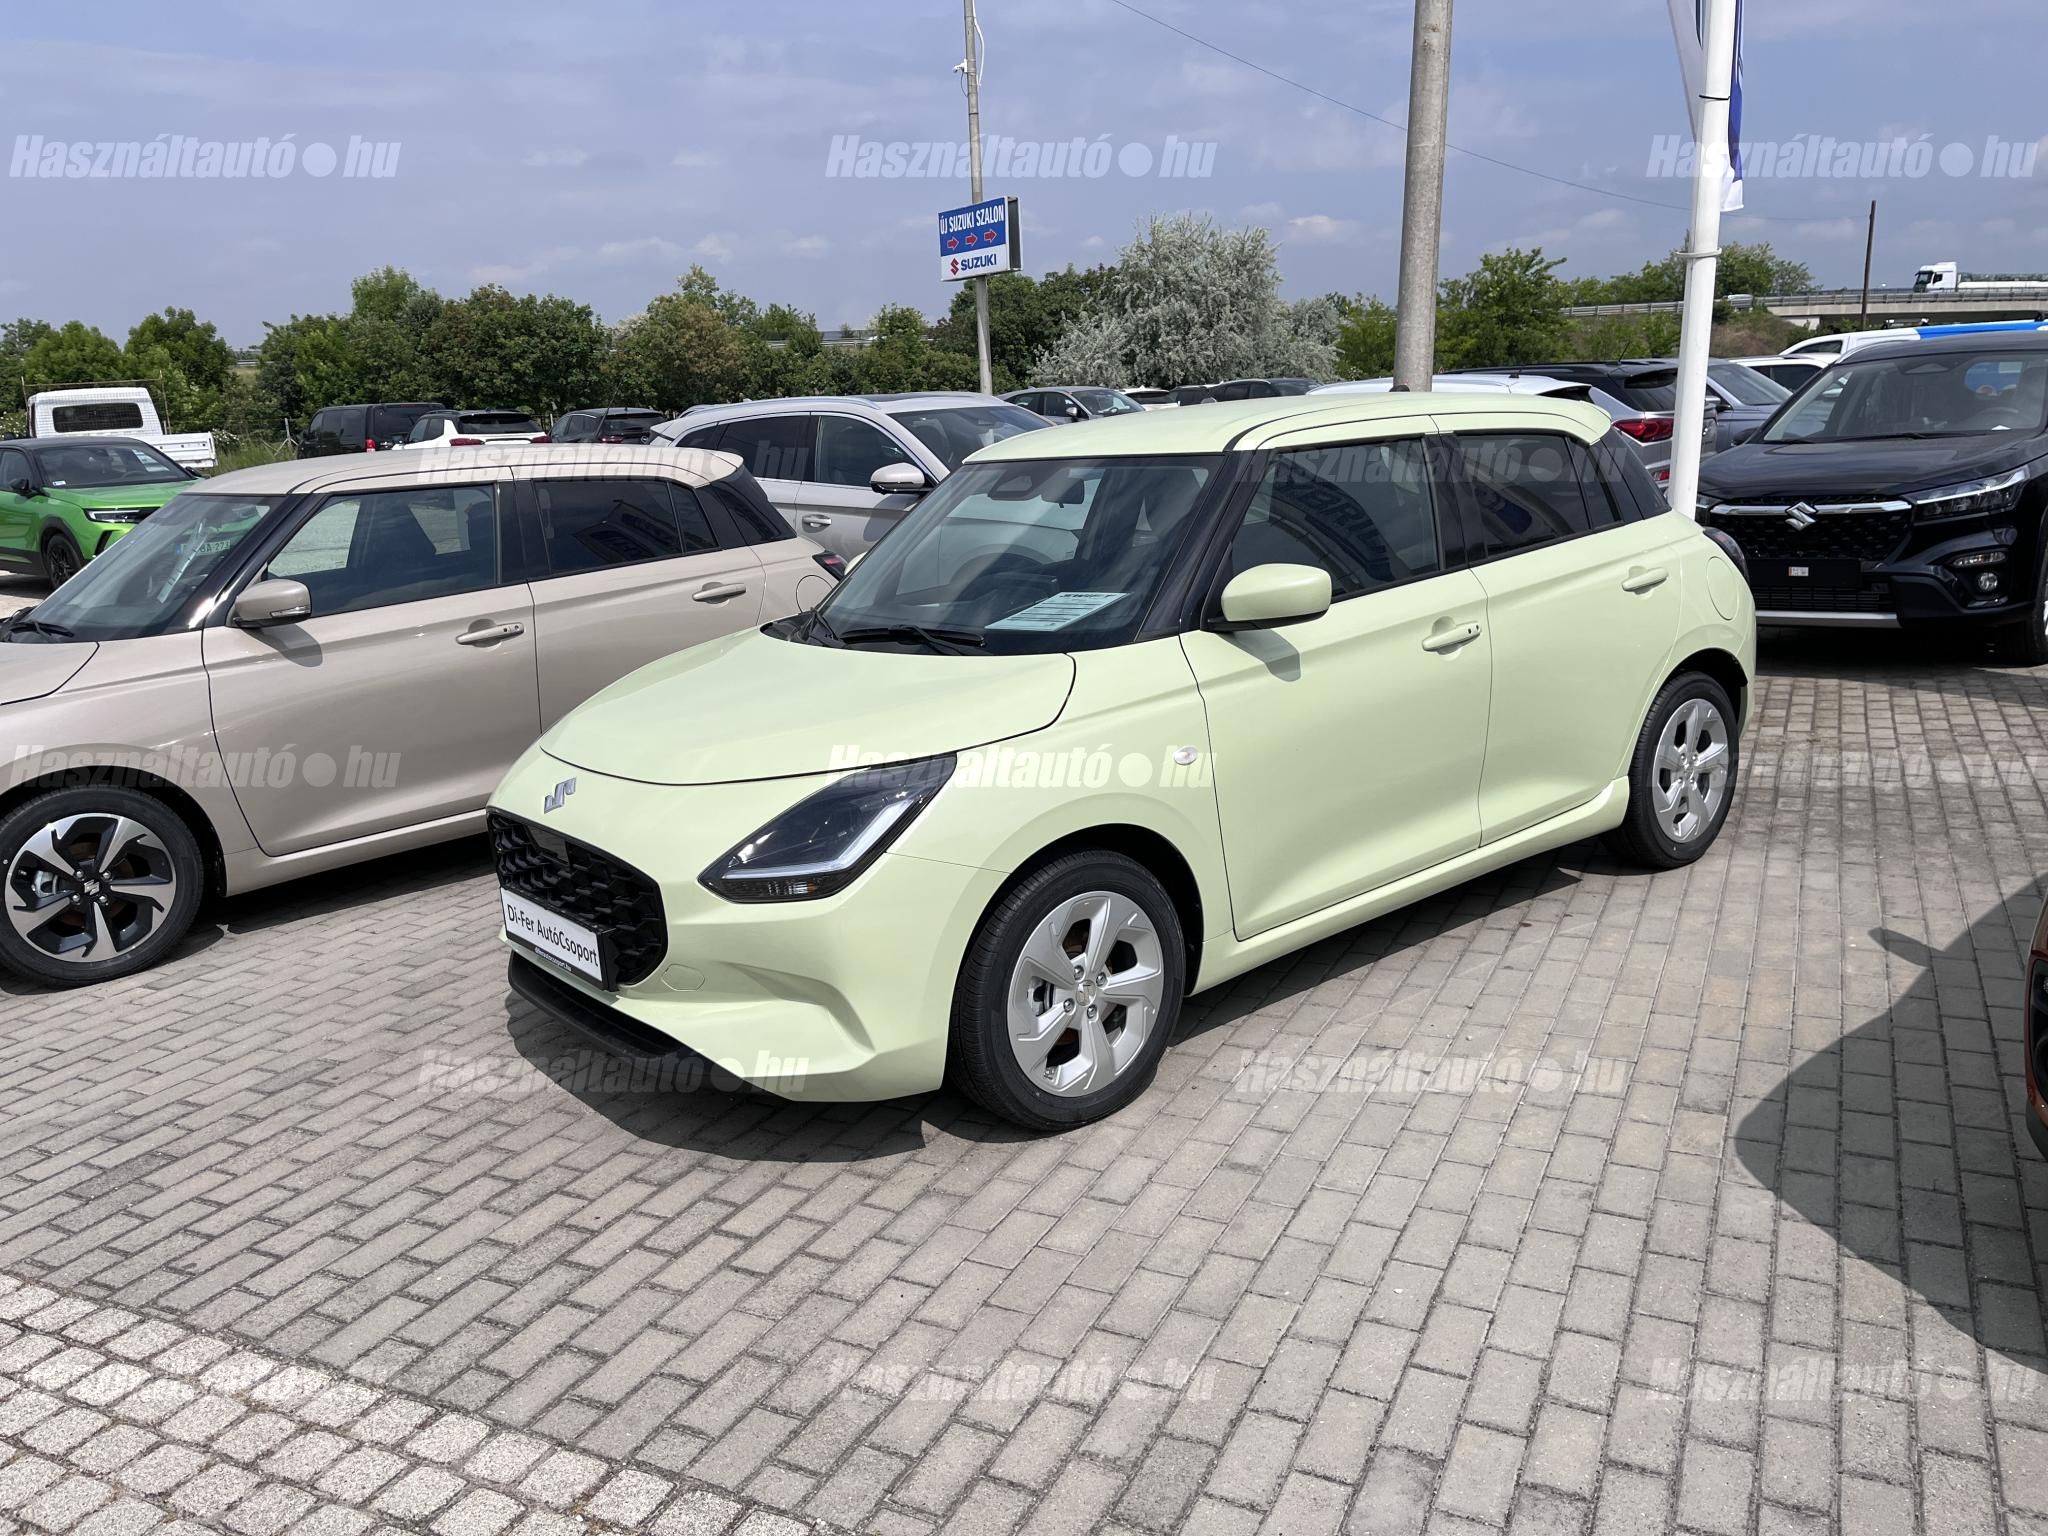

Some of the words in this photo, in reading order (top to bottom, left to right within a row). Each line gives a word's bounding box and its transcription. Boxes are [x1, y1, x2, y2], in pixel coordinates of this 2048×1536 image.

[940, 215, 948, 235] ÚJ
[949, 211, 975, 233] SUZUKI
[977, 204, 1004, 227] SZALON
[960, 253, 997, 271] SUZUKI
[507, 903, 535, 931] Di-Fer
[537, 919, 599, 967] AutóCsoport
